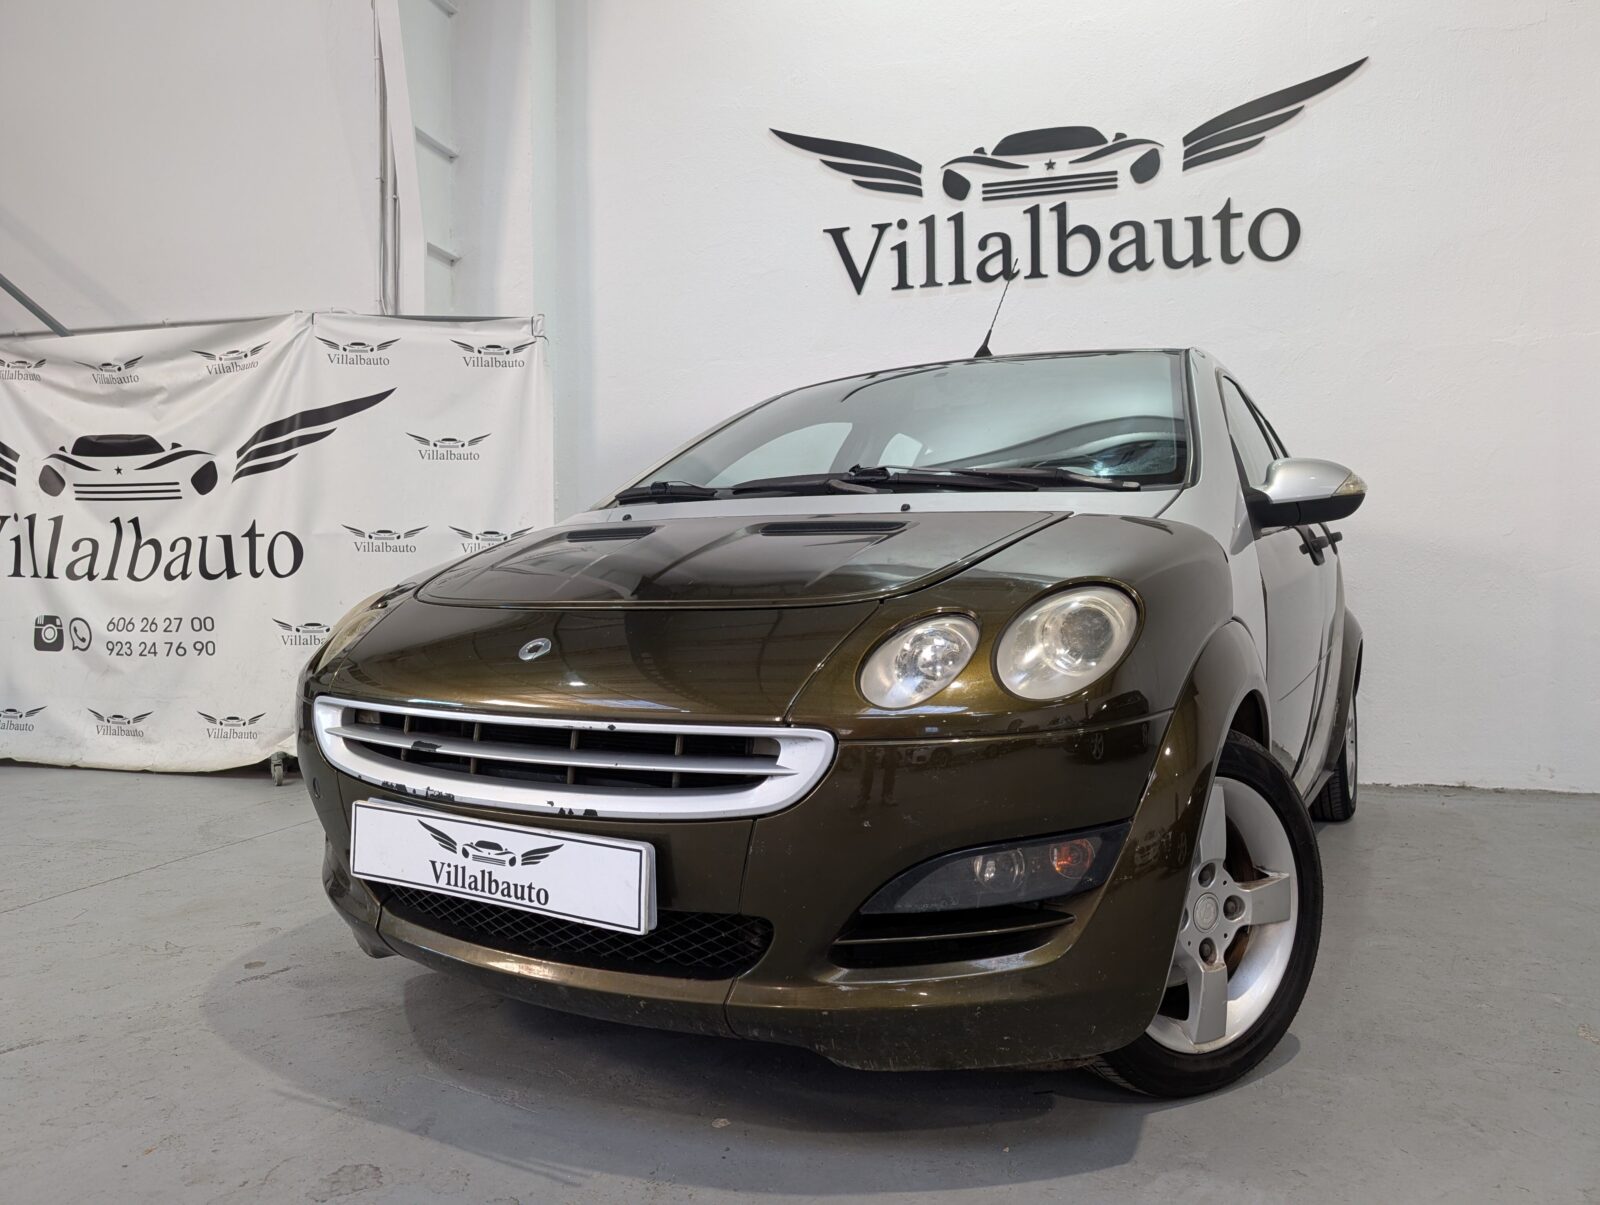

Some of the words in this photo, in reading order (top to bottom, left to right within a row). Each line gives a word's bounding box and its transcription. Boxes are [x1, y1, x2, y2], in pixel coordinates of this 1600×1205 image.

[823, 197, 1302, 295] Villalbauto
[327, 353, 390, 366] Villalbauto
[462, 356, 525, 369] Villalbauto
[205, 359, 260, 376] Villalbauto
[92, 373, 140, 385] Villalbauto
[418, 449, 480, 462] Villalbauto
[353, 540, 417, 554] Villalbauto
[106, 616, 136, 633] 606
[140, 616, 159, 633] 26
[163, 616, 184, 633] 27
[190, 615, 215, 633] 00
[106, 640, 134, 657] 923
[138, 640, 159, 657] 24
[164, 640, 188, 657] 76
[192, 639, 216, 657] 90
[95, 724, 145, 738] Villalbauto
[206, 728, 259, 741] Villalbauto
[428, 859, 550, 906] Villalbauto
